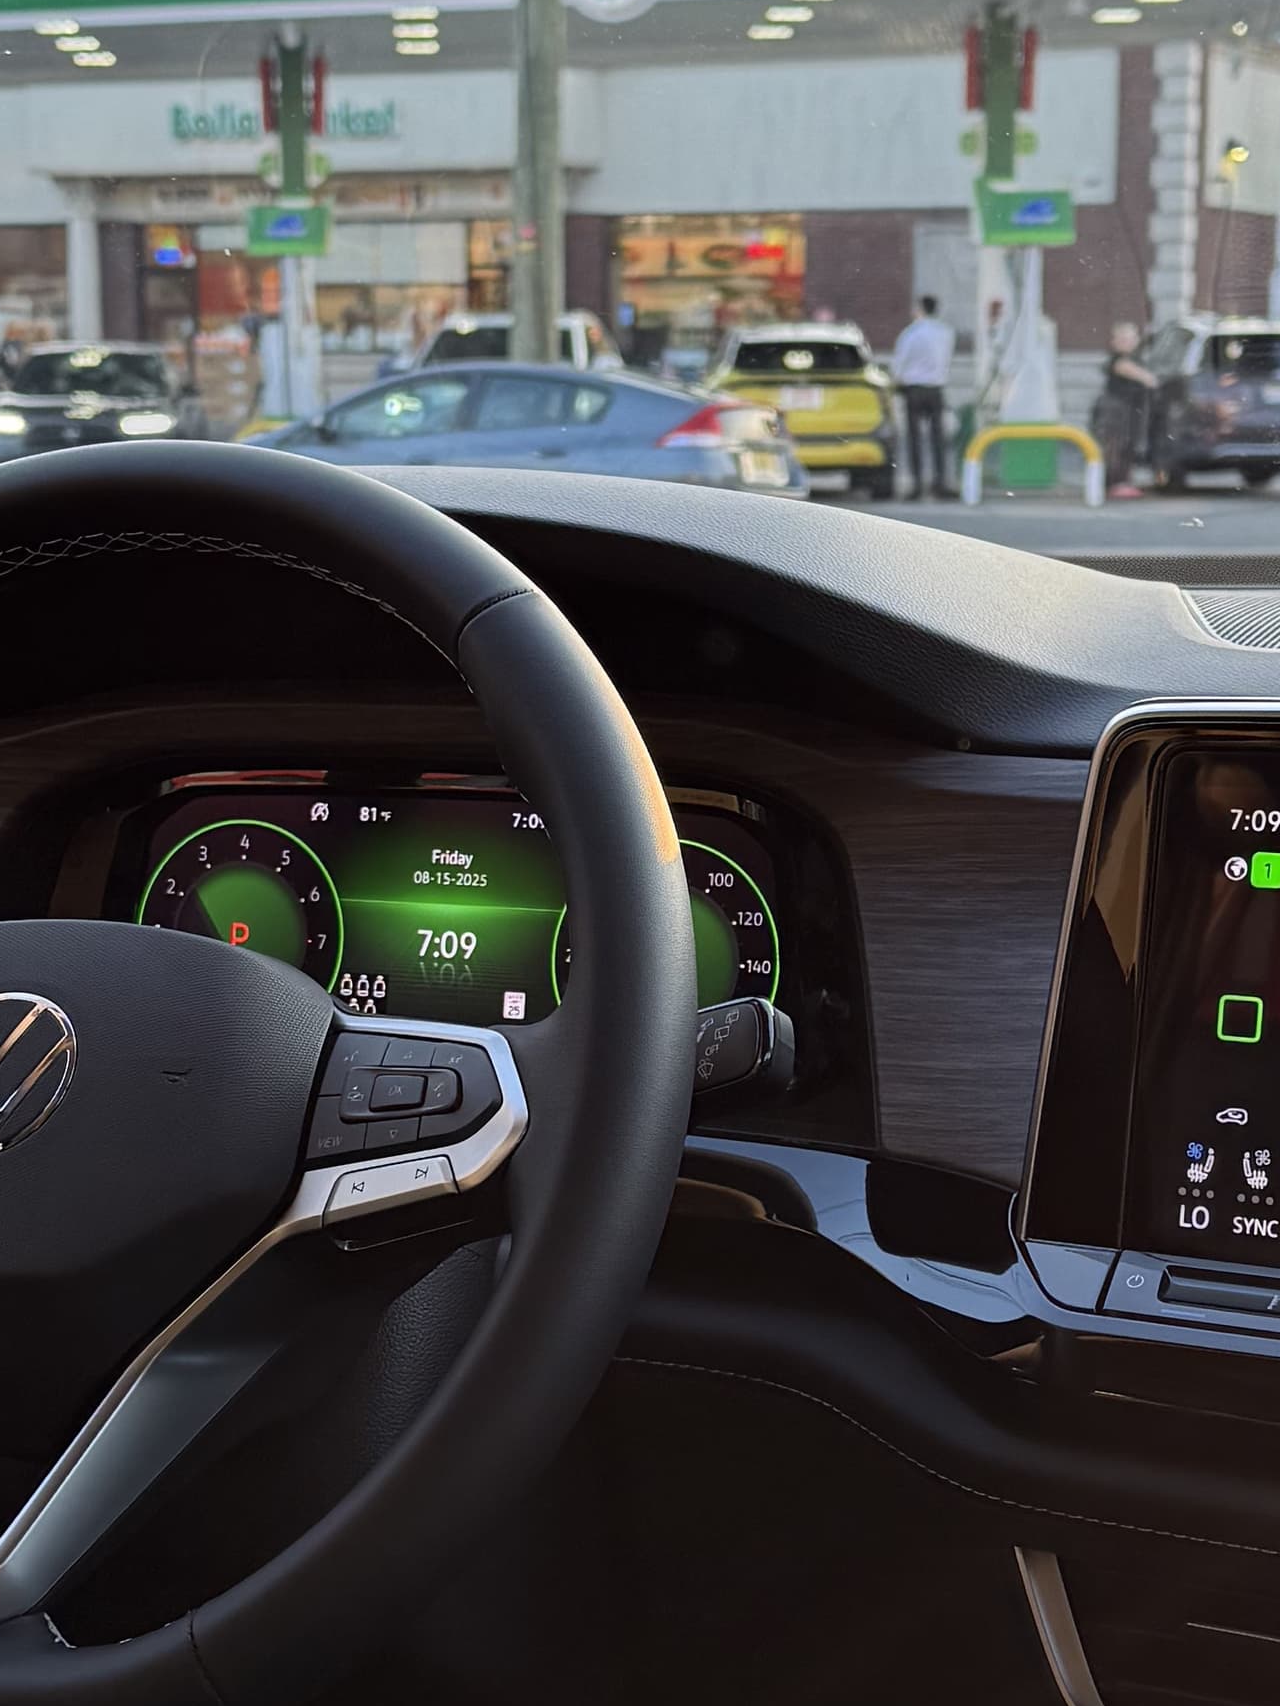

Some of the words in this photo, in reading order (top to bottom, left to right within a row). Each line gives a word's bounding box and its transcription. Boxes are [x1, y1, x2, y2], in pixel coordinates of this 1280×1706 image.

[360, 807, 377, 822] 81
[240, 834, 250, 849] 4
[198, 846, 208, 861] 3
[282, 850, 291, 865] 5
[431, 849, 473, 869] Friday
[166, 878, 176, 894] 2
[413, 871, 488, 887] 08-15-2025
[708, 872, 734, 887] 100
[310, 886, 320, 901] 6
[737, 911, 763, 926] 120
[230, 922, 250, 946] P
[318, 934, 327, 950] 7
[417, 929, 477, 960] 7:09
[746, 959, 771, 974] 140
[508, 1005, 521, 1016] 25
[1178, 1204, 1210, 1229] LO
[1232, 1216, 1279, 1238] SYNC
